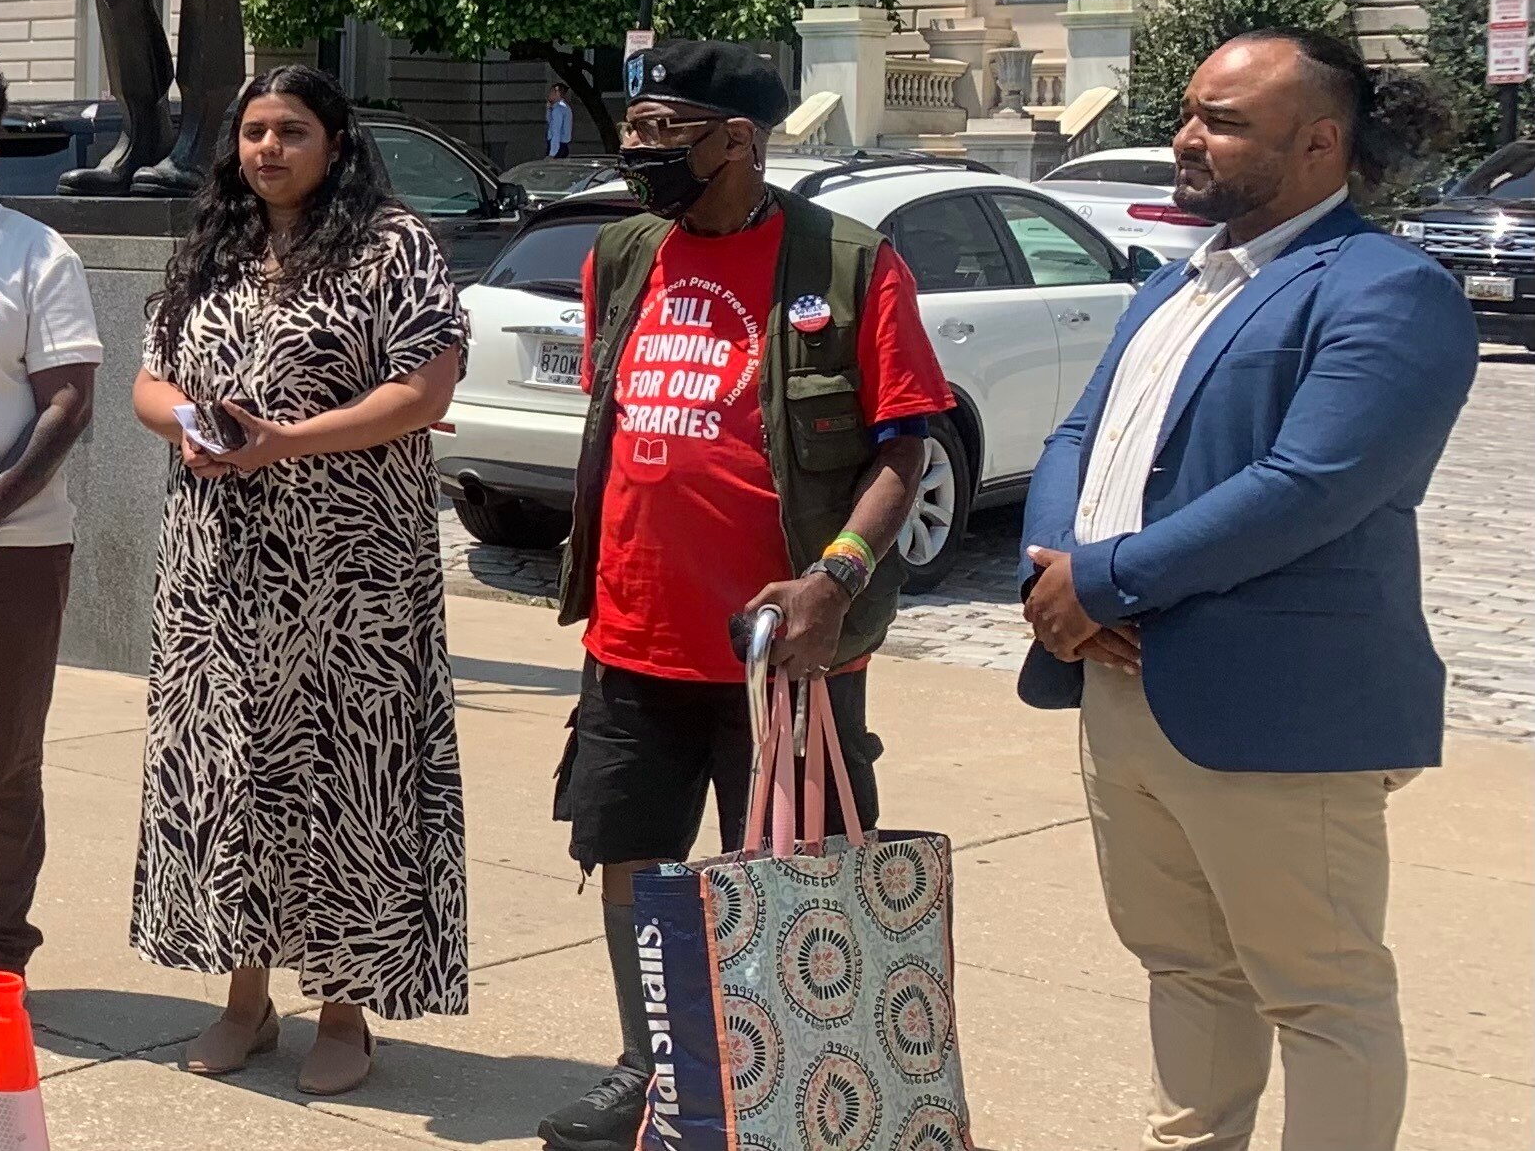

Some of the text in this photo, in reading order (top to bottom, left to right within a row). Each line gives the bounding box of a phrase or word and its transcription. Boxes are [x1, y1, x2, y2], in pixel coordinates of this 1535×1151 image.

[689, 276, 723, 295] Pratt
[659, 297, 713, 328] FULL
[721, 289, 747, 316] Free
[633, 334, 732, 368] FUNDING
[742, 315, 760, 357] Library
[626, 370, 665, 399] FOR
[667, 369, 721, 402] OUR
[722, 358, 760, 407] Support
